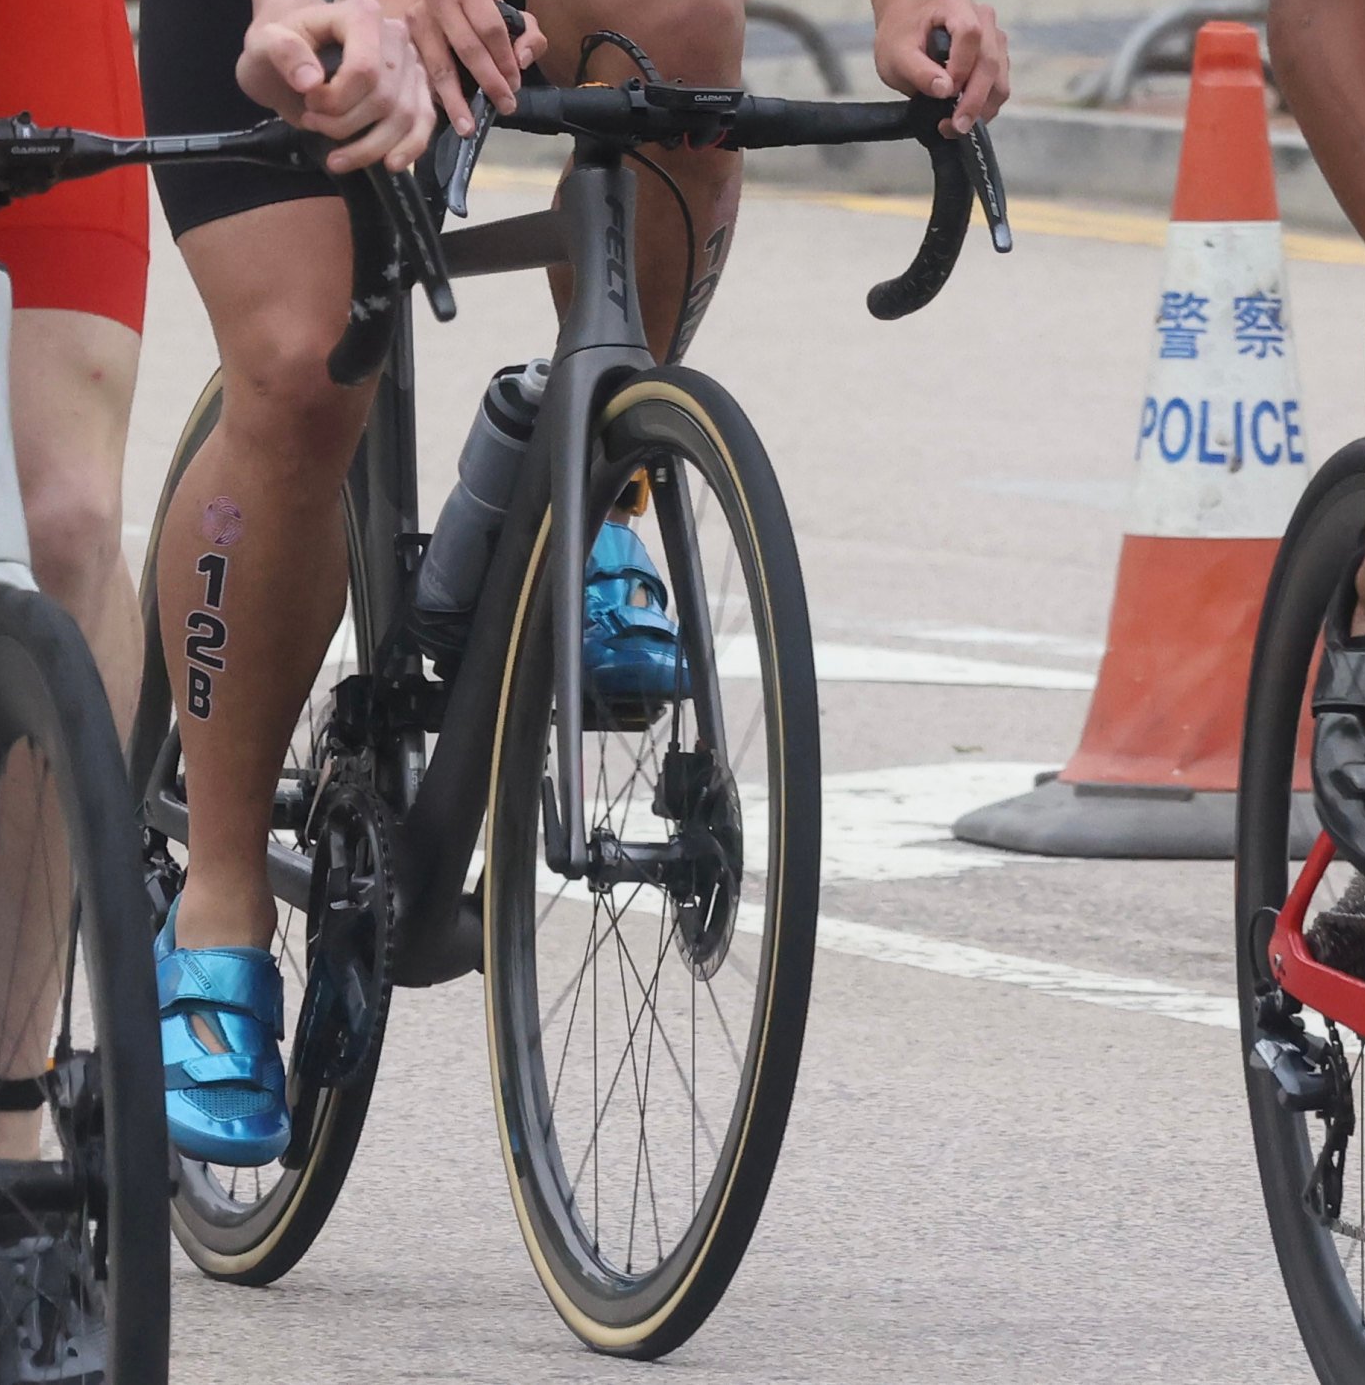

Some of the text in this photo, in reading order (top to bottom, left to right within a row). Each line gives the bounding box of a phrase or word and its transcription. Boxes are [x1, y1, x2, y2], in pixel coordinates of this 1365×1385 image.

[694, 94, 732, 103] GARMIN
[605, 194, 628, 323] FELT
[1156, 290, 1286, 360] 警察
[1135, 396, 1305, 465] POLICE
[185, 546, 228, 721] 12B
[183, 956, 212, 992] SHIMANO
